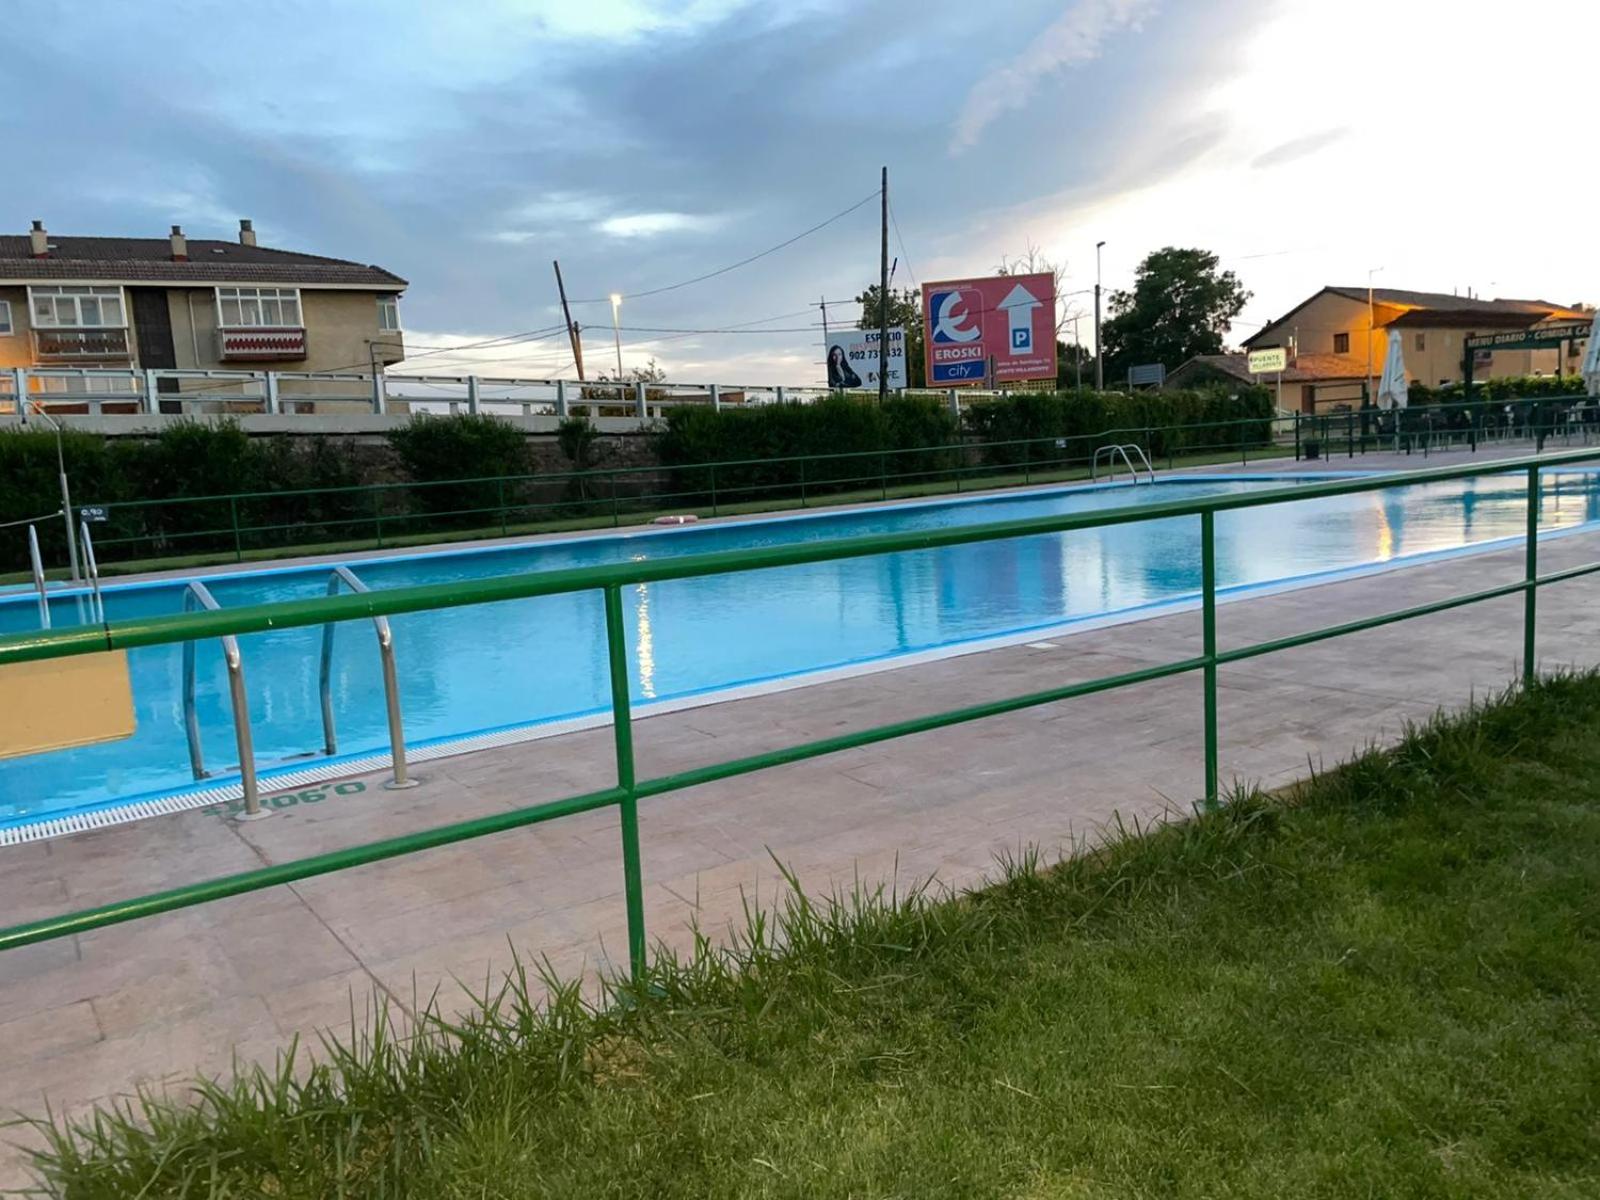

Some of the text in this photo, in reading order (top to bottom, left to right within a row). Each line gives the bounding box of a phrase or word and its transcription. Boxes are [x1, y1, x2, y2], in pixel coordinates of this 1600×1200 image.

[1016, 331, 1027, 345] P
[849, 351, 866, 360] 902
[935, 346, 982, 360] EROSKI
[948, 364, 972, 378] city
